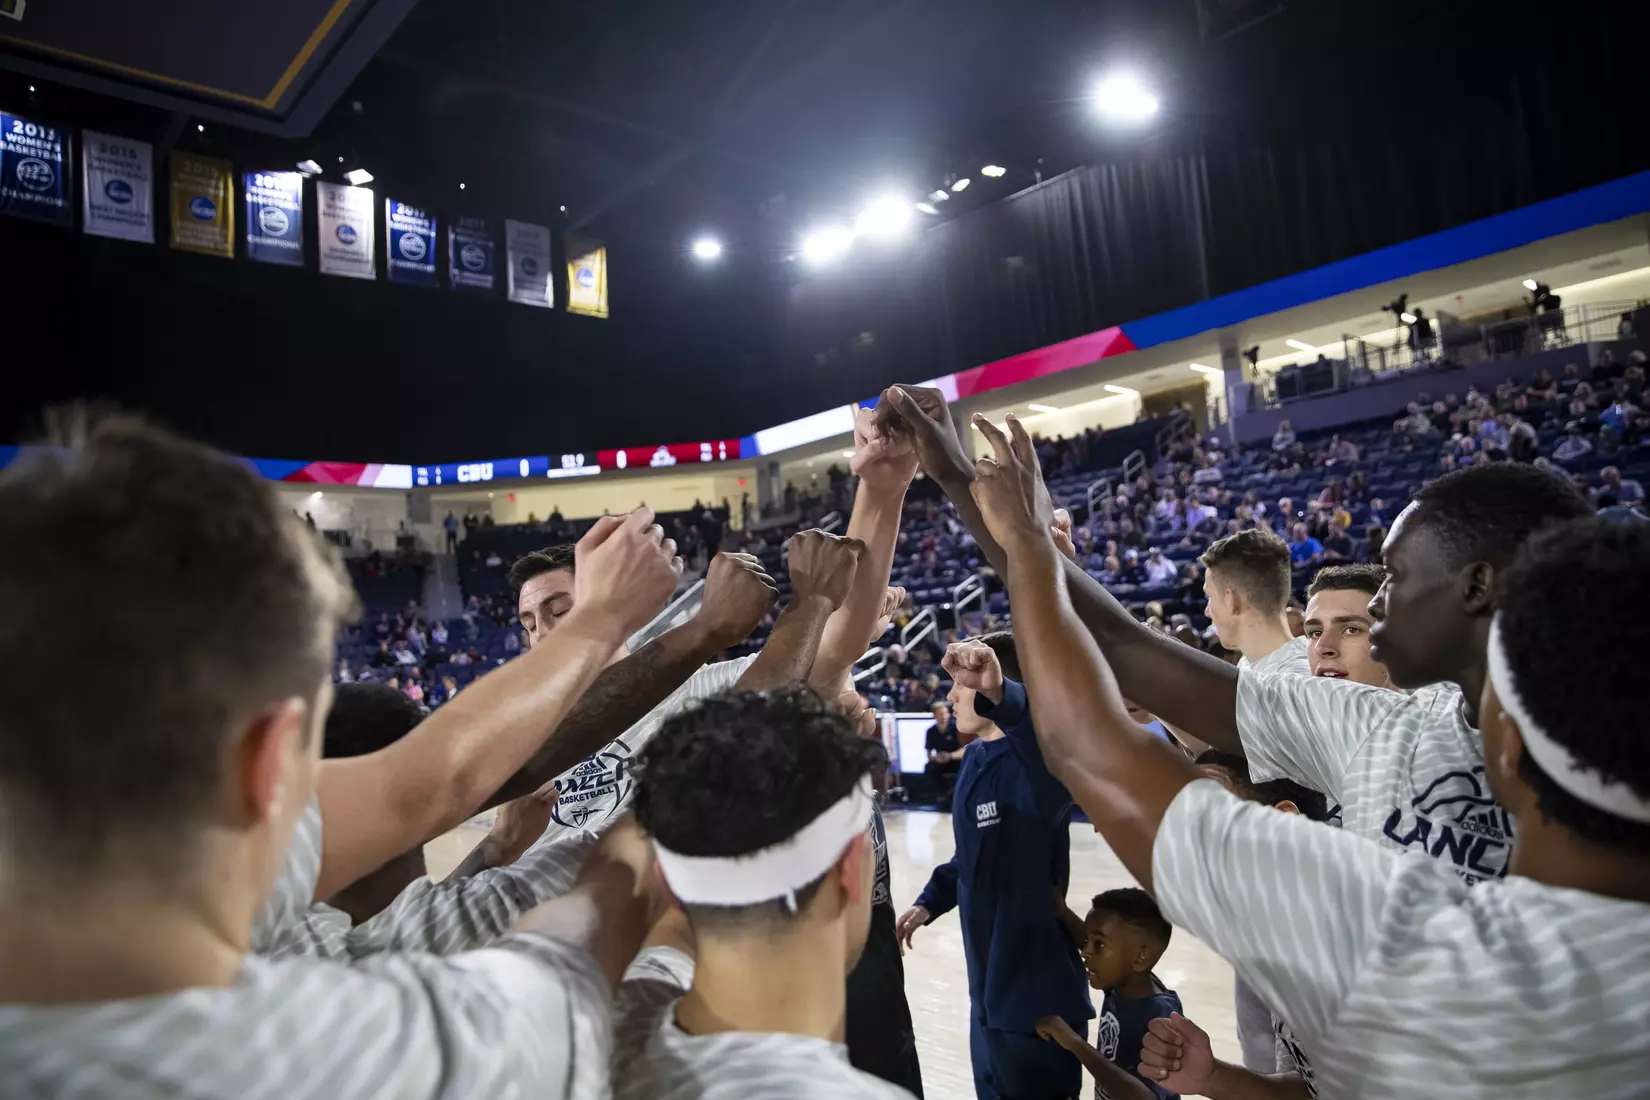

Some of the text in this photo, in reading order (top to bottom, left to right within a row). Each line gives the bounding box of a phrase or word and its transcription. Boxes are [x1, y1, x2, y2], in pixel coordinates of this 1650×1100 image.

[576, 767, 603, 777] adidas
[559, 786, 614, 806] BASKETBALL
[976, 801, 997, 820] CBU
[1461, 819, 1504, 839] adidas
